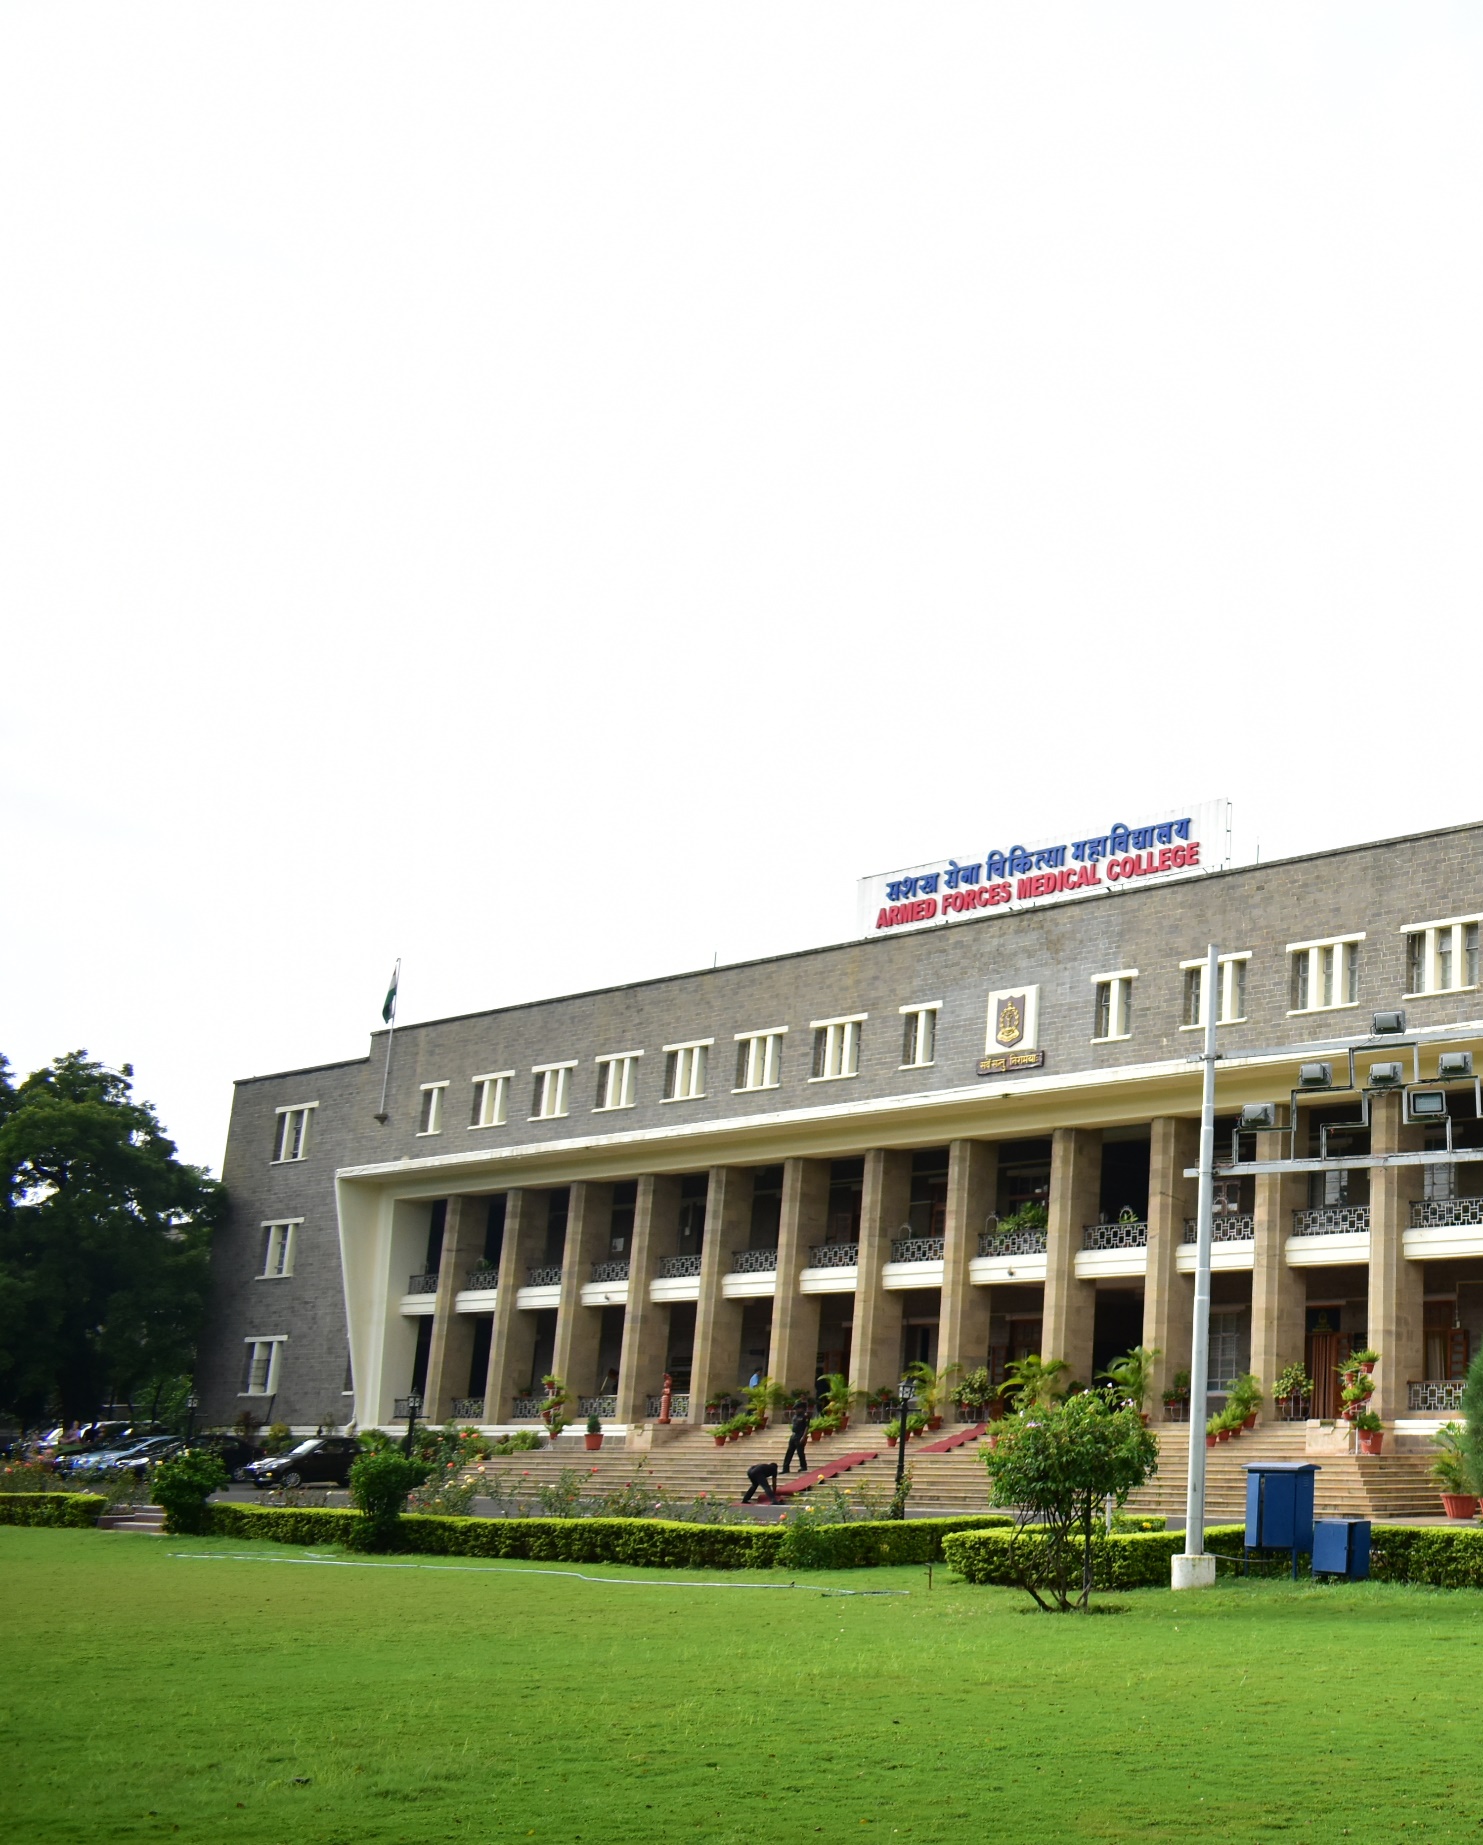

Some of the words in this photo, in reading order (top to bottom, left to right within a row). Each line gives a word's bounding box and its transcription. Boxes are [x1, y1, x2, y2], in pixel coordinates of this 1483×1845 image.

[875, 897, 937, 929] ARMED
[941, 881, 1012, 916] FORCES
[1016, 863, 1102, 900] MEDICAL
[1106, 842, 1200, 881] COLLEGE
[886, 872, 940, 901] सशस्त्र
[944, 860, 982, 889] सेना
[985, 845, 1067, 881] चिकित्सा
[1071, 817, 1191, 863] महाविद्यालय
